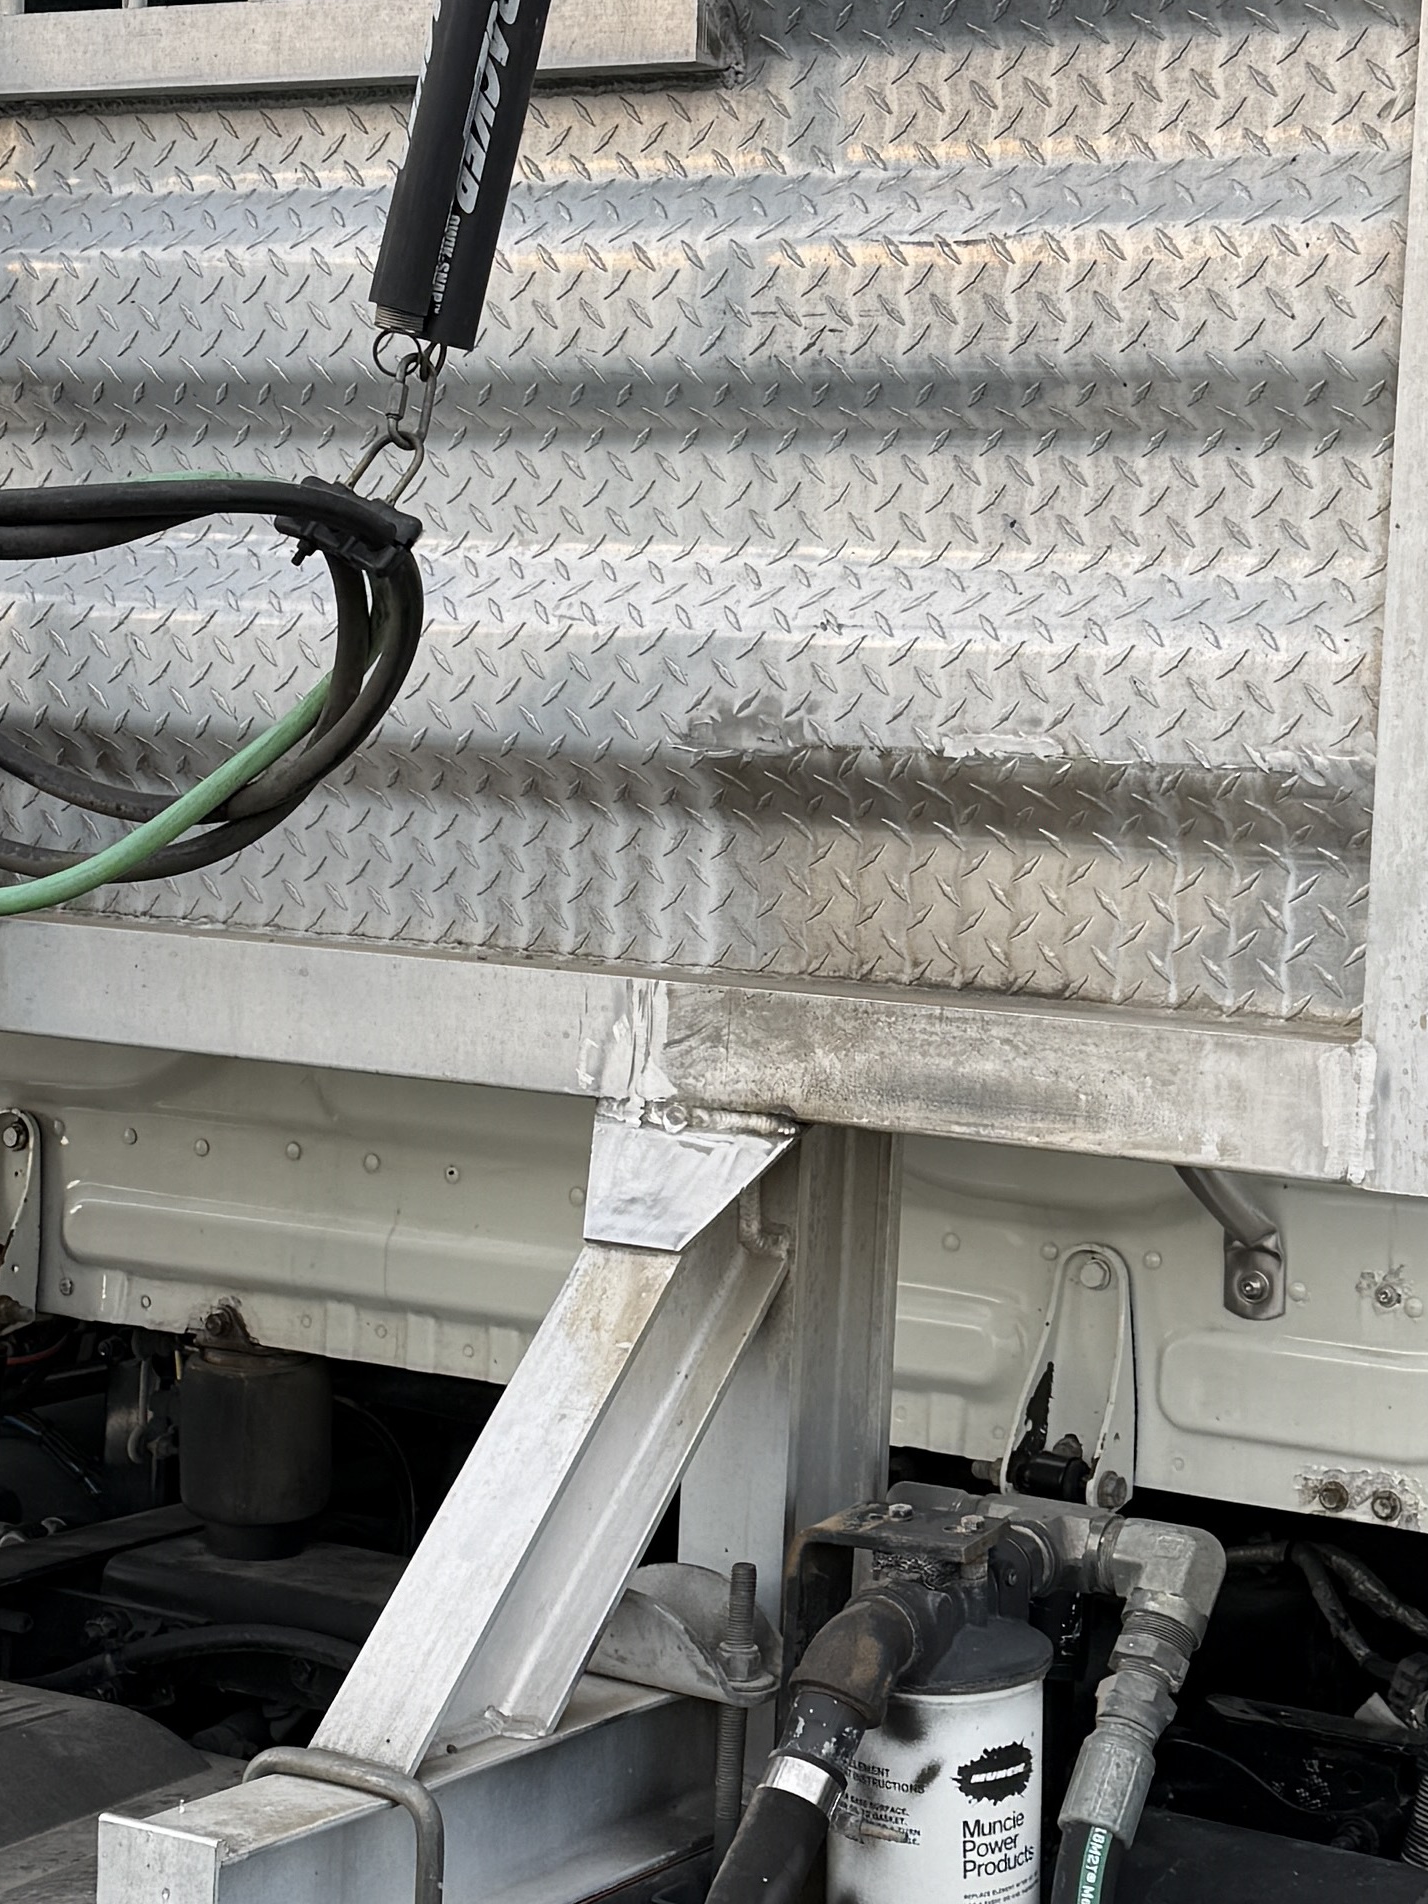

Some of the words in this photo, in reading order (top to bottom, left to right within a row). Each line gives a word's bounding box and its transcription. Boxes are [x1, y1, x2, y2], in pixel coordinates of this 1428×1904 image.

[962, 1810, 1025, 1839] Muncie
[962, 1833, 1020, 1859] Power
[963, 1844, 1035, 1879] Products
